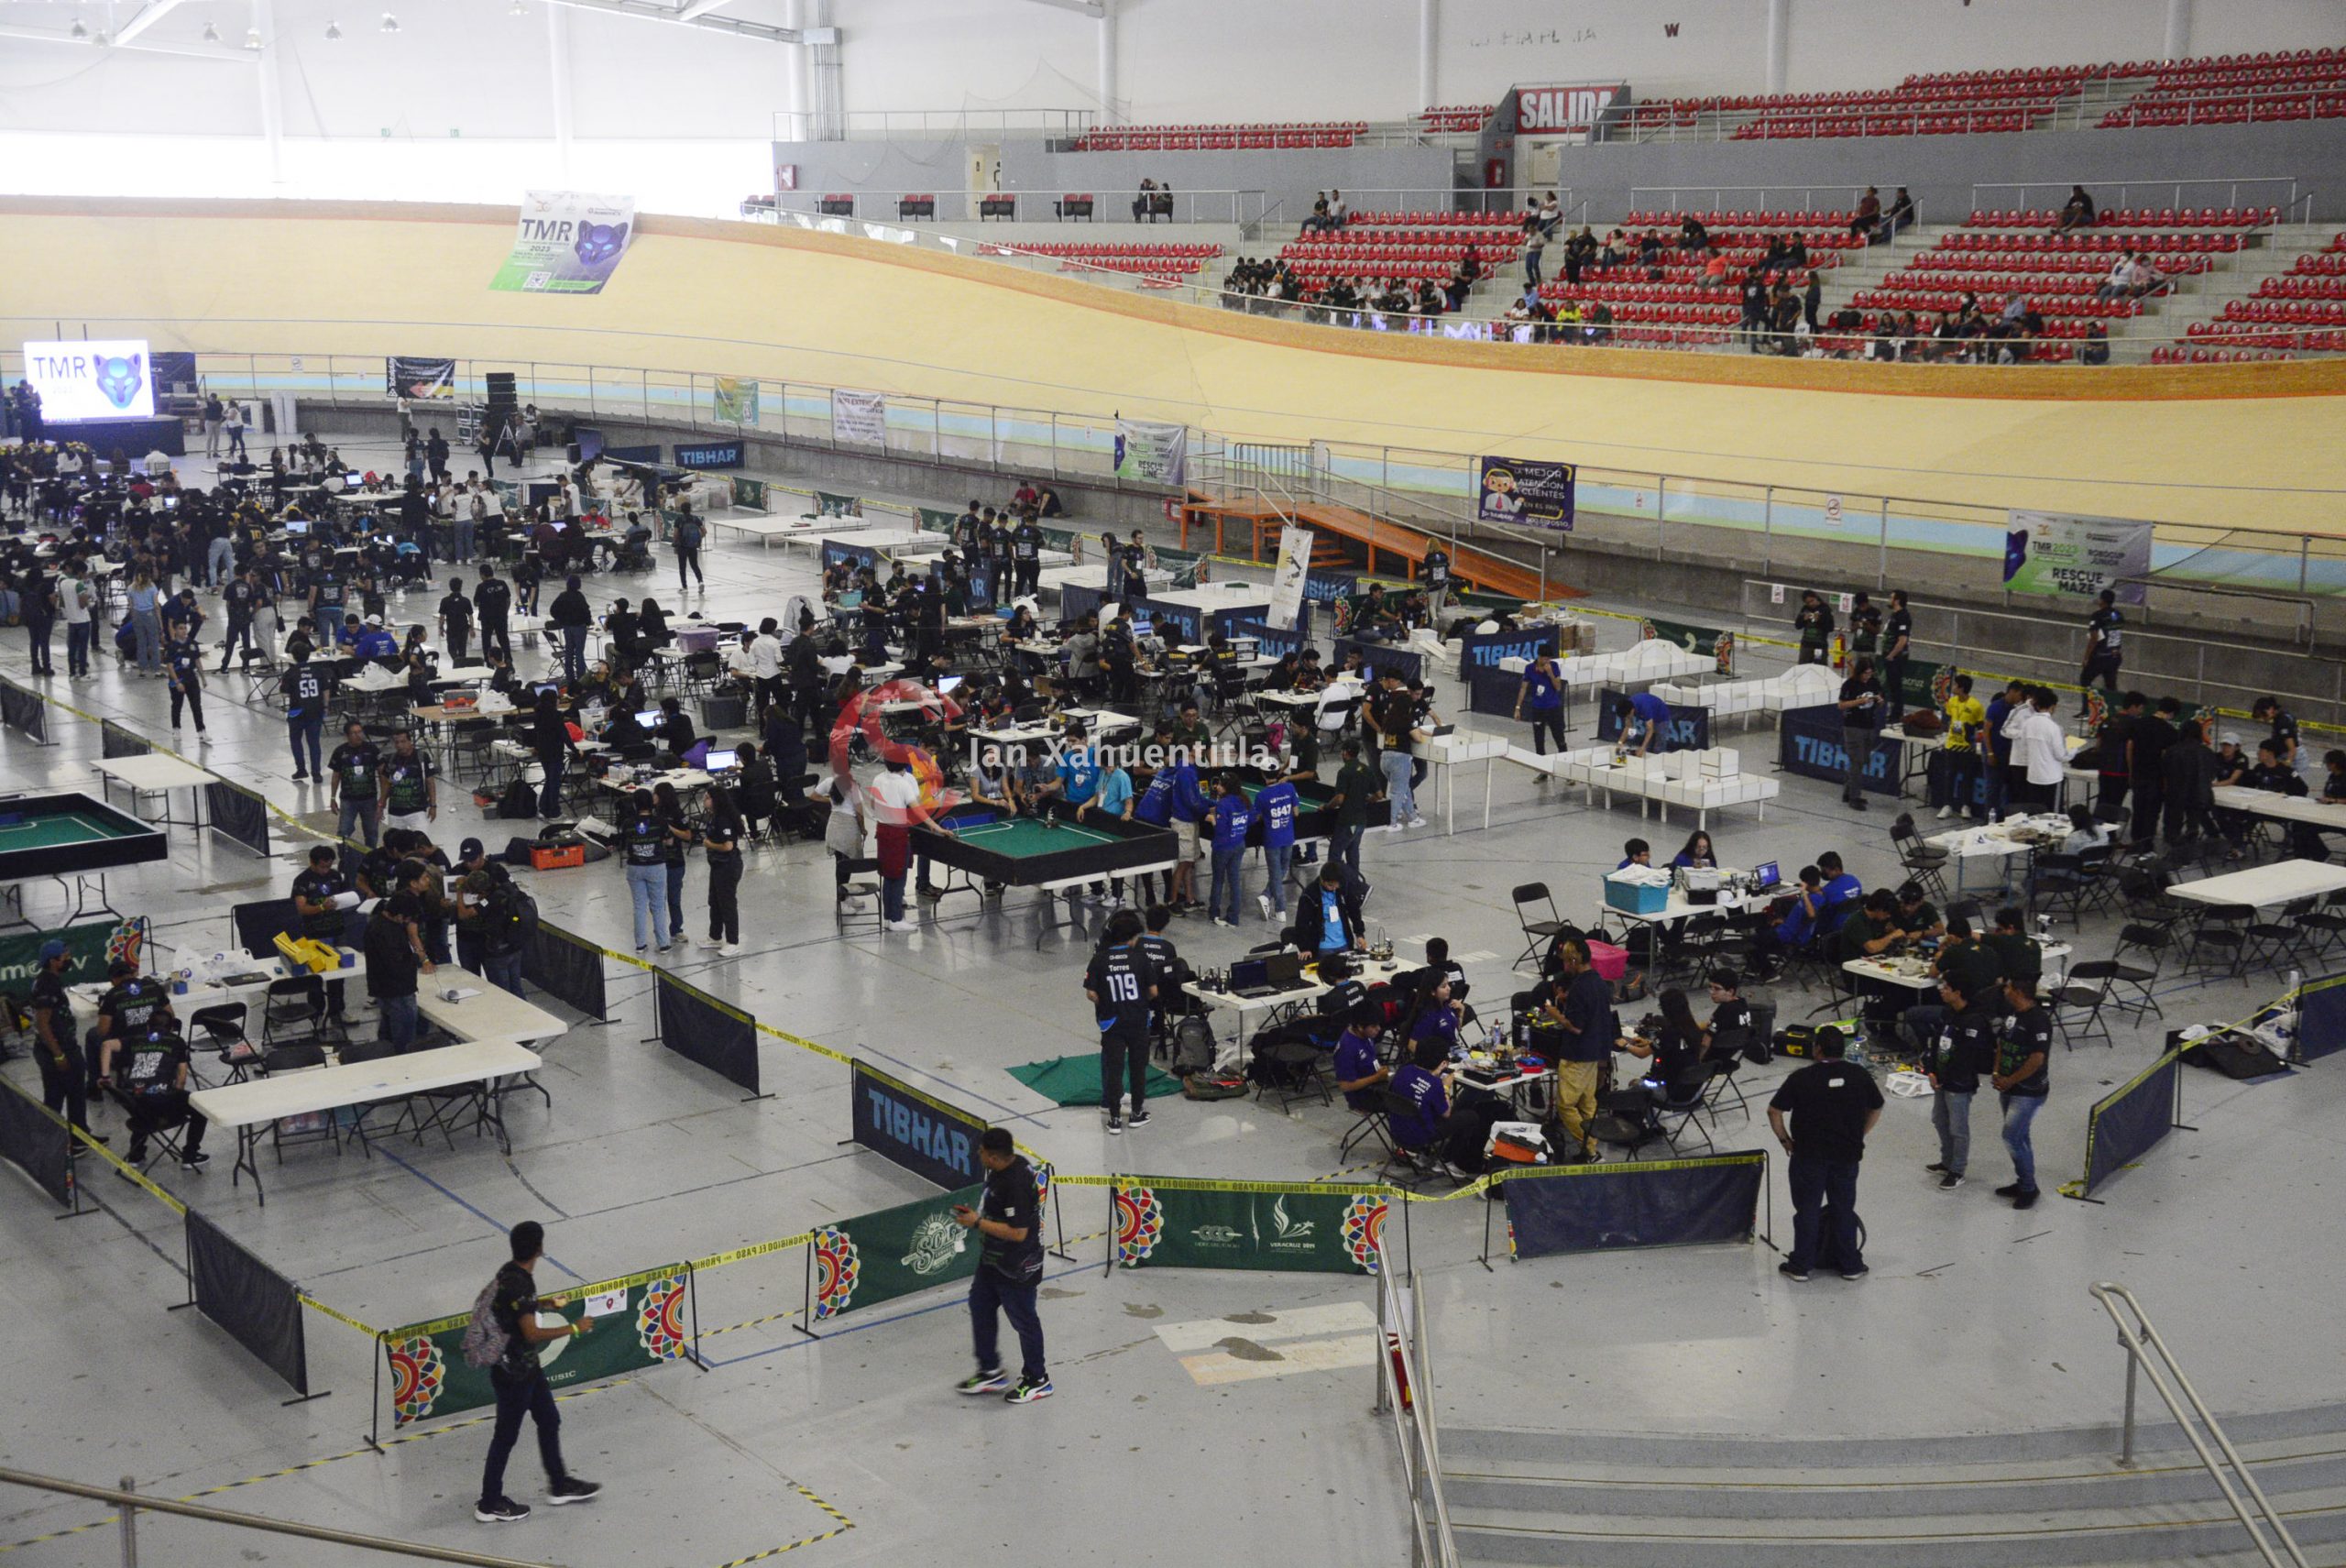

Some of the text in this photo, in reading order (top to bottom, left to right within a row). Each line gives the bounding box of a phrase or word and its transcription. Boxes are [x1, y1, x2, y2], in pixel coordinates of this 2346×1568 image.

[1520, 90, 1614, 129] SALIDA
[521, 218, 573, 241] TMR
[33, 356, 87, 379] TMR
[681, 449, 737, 465] TIBHAR
[1138, 460, 1164, 471] RESCUE
[1525, 467, 1562, 477] MEJOR
[1521, 488, 1565, 499] CLIENTES
[2033, 541, 2052, 553] TMR
[2053, 567, 2104, 584] RESCUE
[2058, 581, 2096, 595] MAZE
[299, 678, 319, 698] 59
[1106, 973, 1138, 1003] 119
[868, 1088, 971, 1177] TIBHAR
